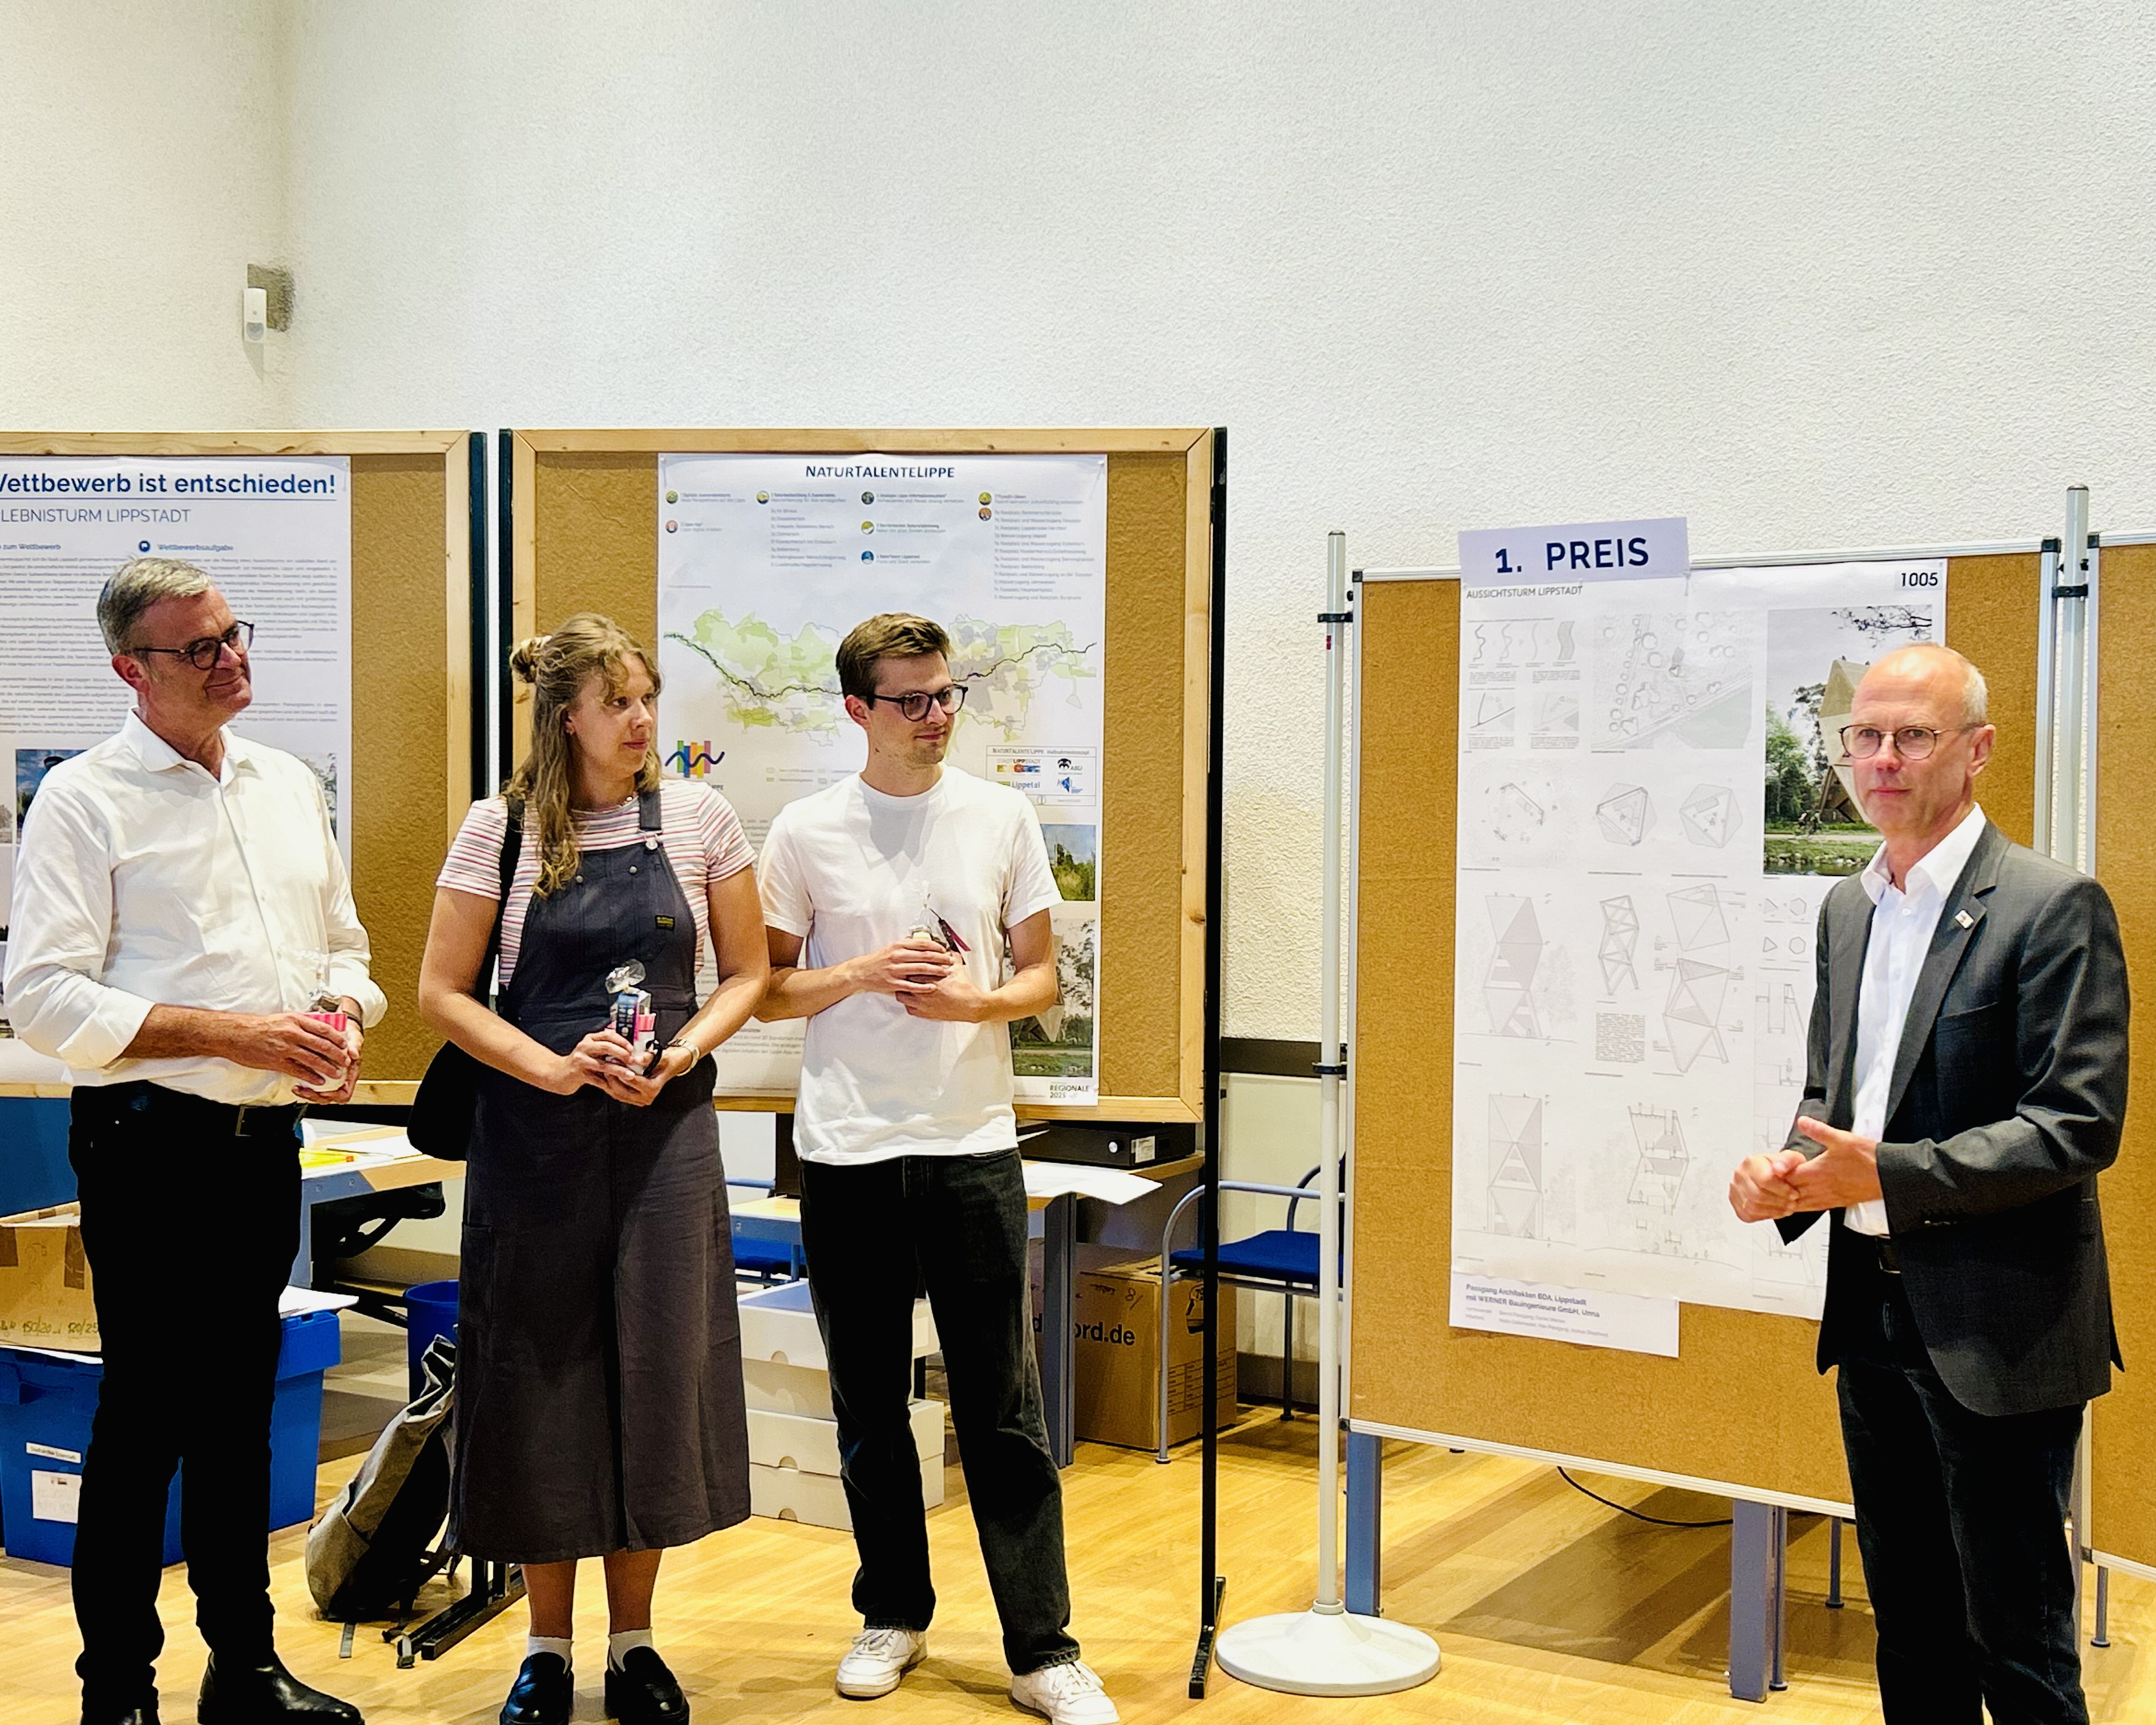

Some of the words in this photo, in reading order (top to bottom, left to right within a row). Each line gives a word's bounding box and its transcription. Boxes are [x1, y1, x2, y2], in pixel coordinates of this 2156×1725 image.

[139, 473, 167, 493] ist
[174, 473, 336, 494] entschieden!
[0, 508, 102, 522] LEBNISTURM
[107, 509, 191, 523] LIPPSTADT
[1495, 548, 1522, 574] 1.
[1546, 537, 1649, 571] PREIS
[1900, 572, 1939, 587] 1005
[1466, 588, 1536, 599] AUSSICHTSTURM
[1537, 585, 1583, 596] LIPPSTADT
[1478, 1296, 1508, 1305] WERNER
[1508, 1299, 1557, 1311] Bauingenieure
[1498, 1288, 1537, 1299] Architekten
[1554, 1295, 1587, 1305] Lippstadt
